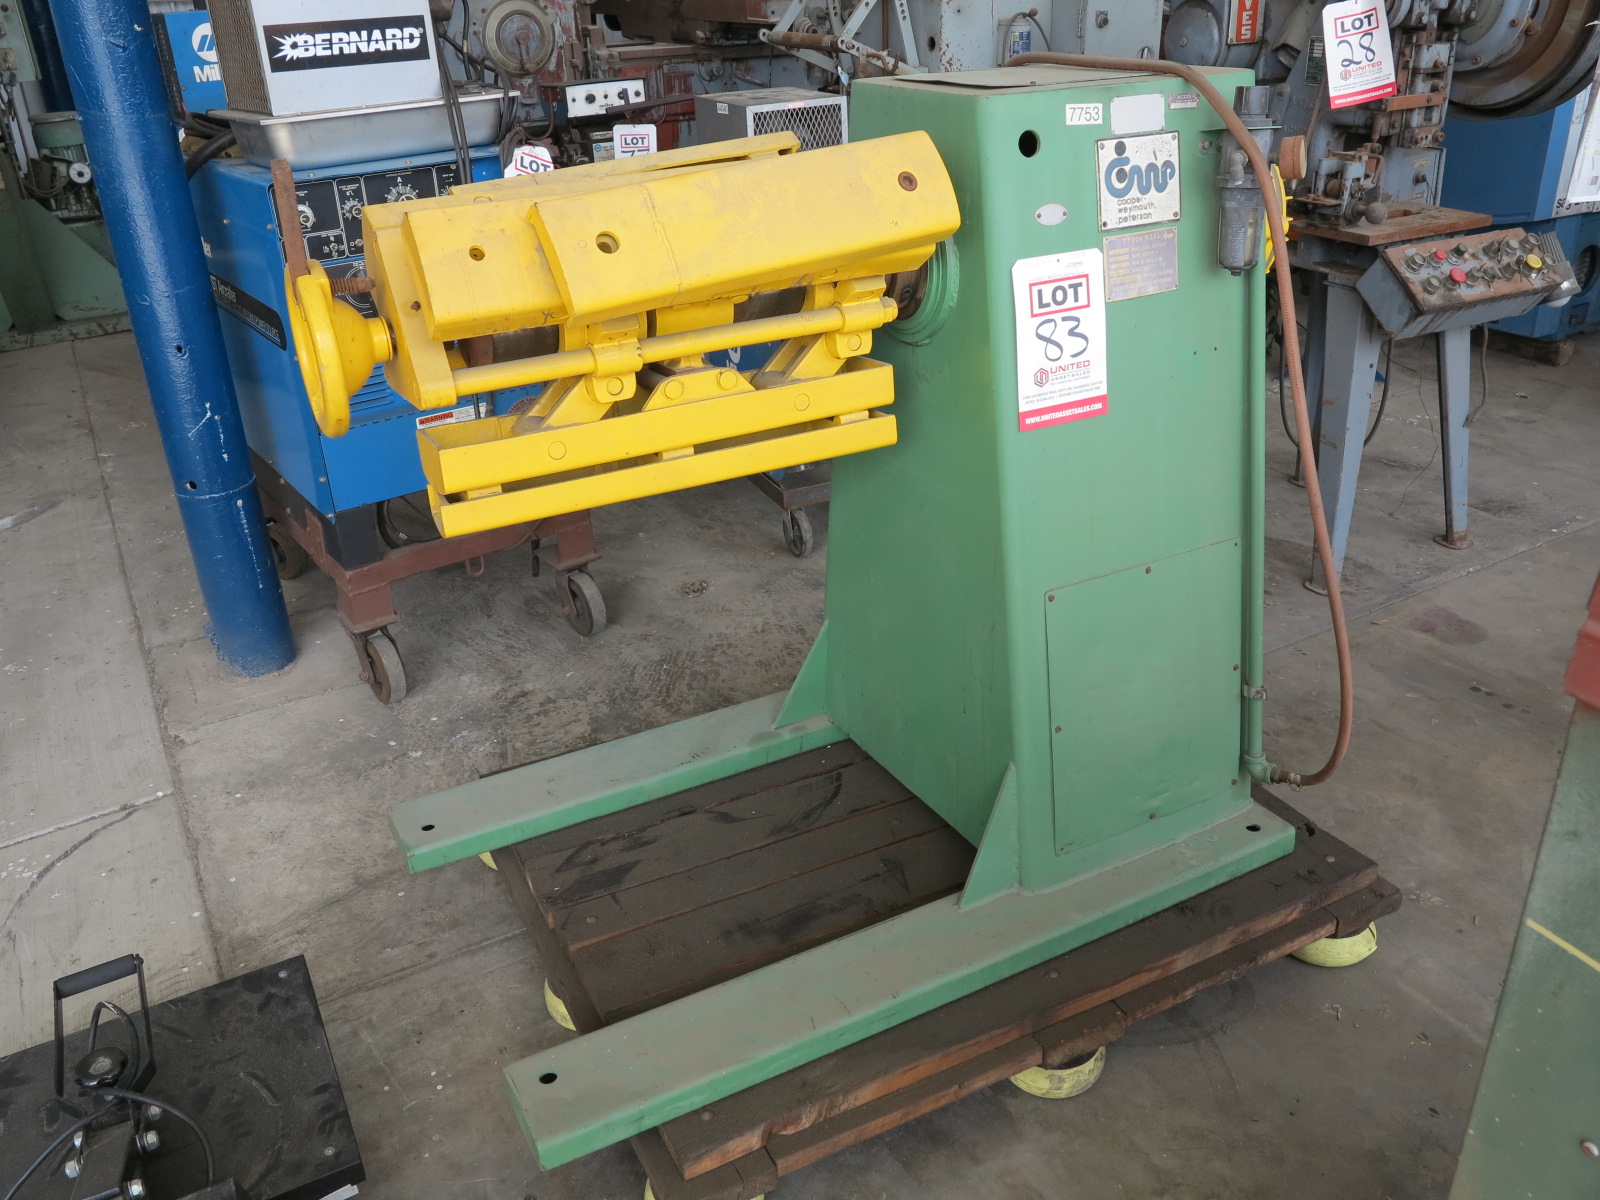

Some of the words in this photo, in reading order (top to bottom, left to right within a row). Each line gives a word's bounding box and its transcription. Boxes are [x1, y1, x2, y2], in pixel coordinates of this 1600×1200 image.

[1340, 12, 1374, 33] LOT
[1336, 32, 1376, 68] 28
[193, 63, 222, 83] Mil
[1352, 60, 1383, 73] UNITED
[1068, 105, 1100, 123] 7753
[624, 136, 646, 146] LOT
[520, 155, 551, 173] LOT
[1118, 212, 1153, 225] peterson
[1122, 235, 1144, 245] STOCK
[1145, 232, 1162, 241] REEL
[1036, 281, 1083, 309] LOT
[1035, 315, 1089, 362] 83
[1050, 359, 1091, 375] UNITED
[423, 411, 454, 424] WARNING
[1025, 402, 1103, 425] WWW.UNITEDASSETSALES.COM
